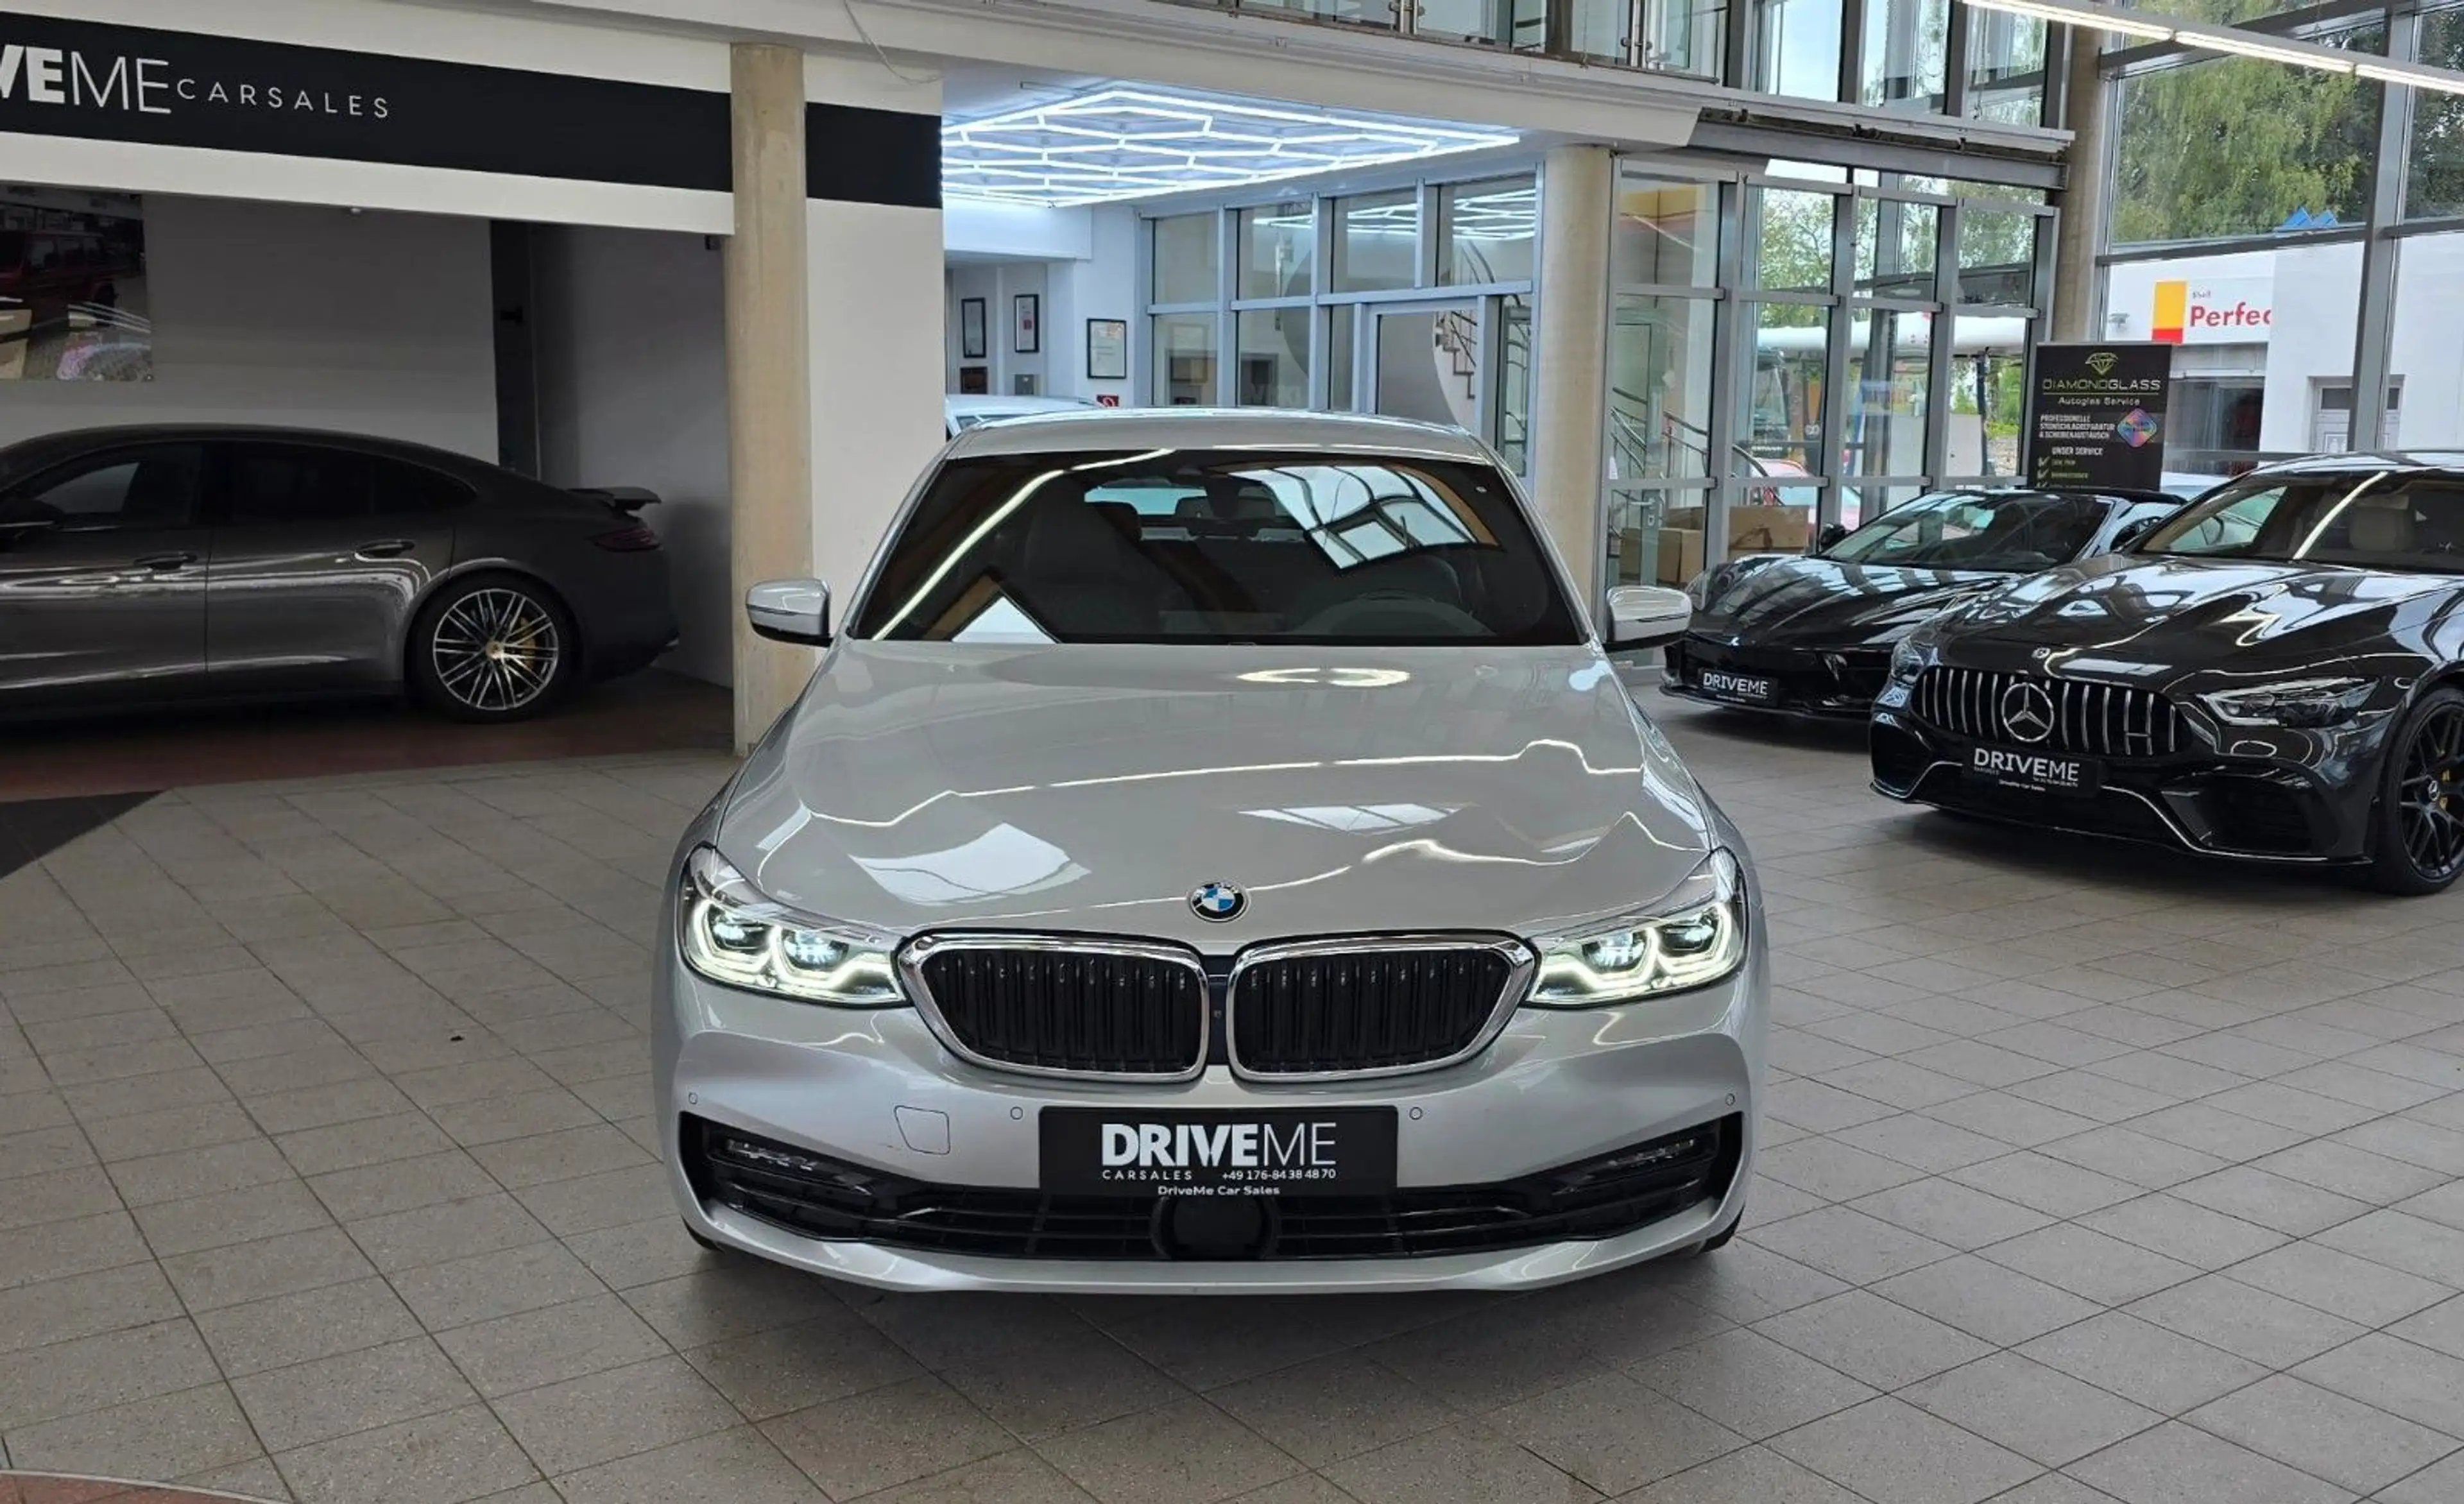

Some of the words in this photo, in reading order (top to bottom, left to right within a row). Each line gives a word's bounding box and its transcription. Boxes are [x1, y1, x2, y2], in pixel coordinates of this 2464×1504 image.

[176, 78, 389, 119] CARSALES
[2058, 396, 2101, 407] Autoglas
[2103, 396, 2141, 406] Service
[1703, 672, 1769, 696] DRIVEME
[1974, 748, 2080, 782] DRIVEME
[1101, 1122, 1337, 1167] DRIVEME
[1102, 1170, 1192, 1181] CARSALES
[1222, 1170, 1244, 1181] +49
[1247, 1170, 1287, 1181] 176-84
[1158, 1186, 1214, 1196] DriveMe
[1217, 1186, 1240, 1195] Car
[1243, 1186, 1280, 1196] Sales
